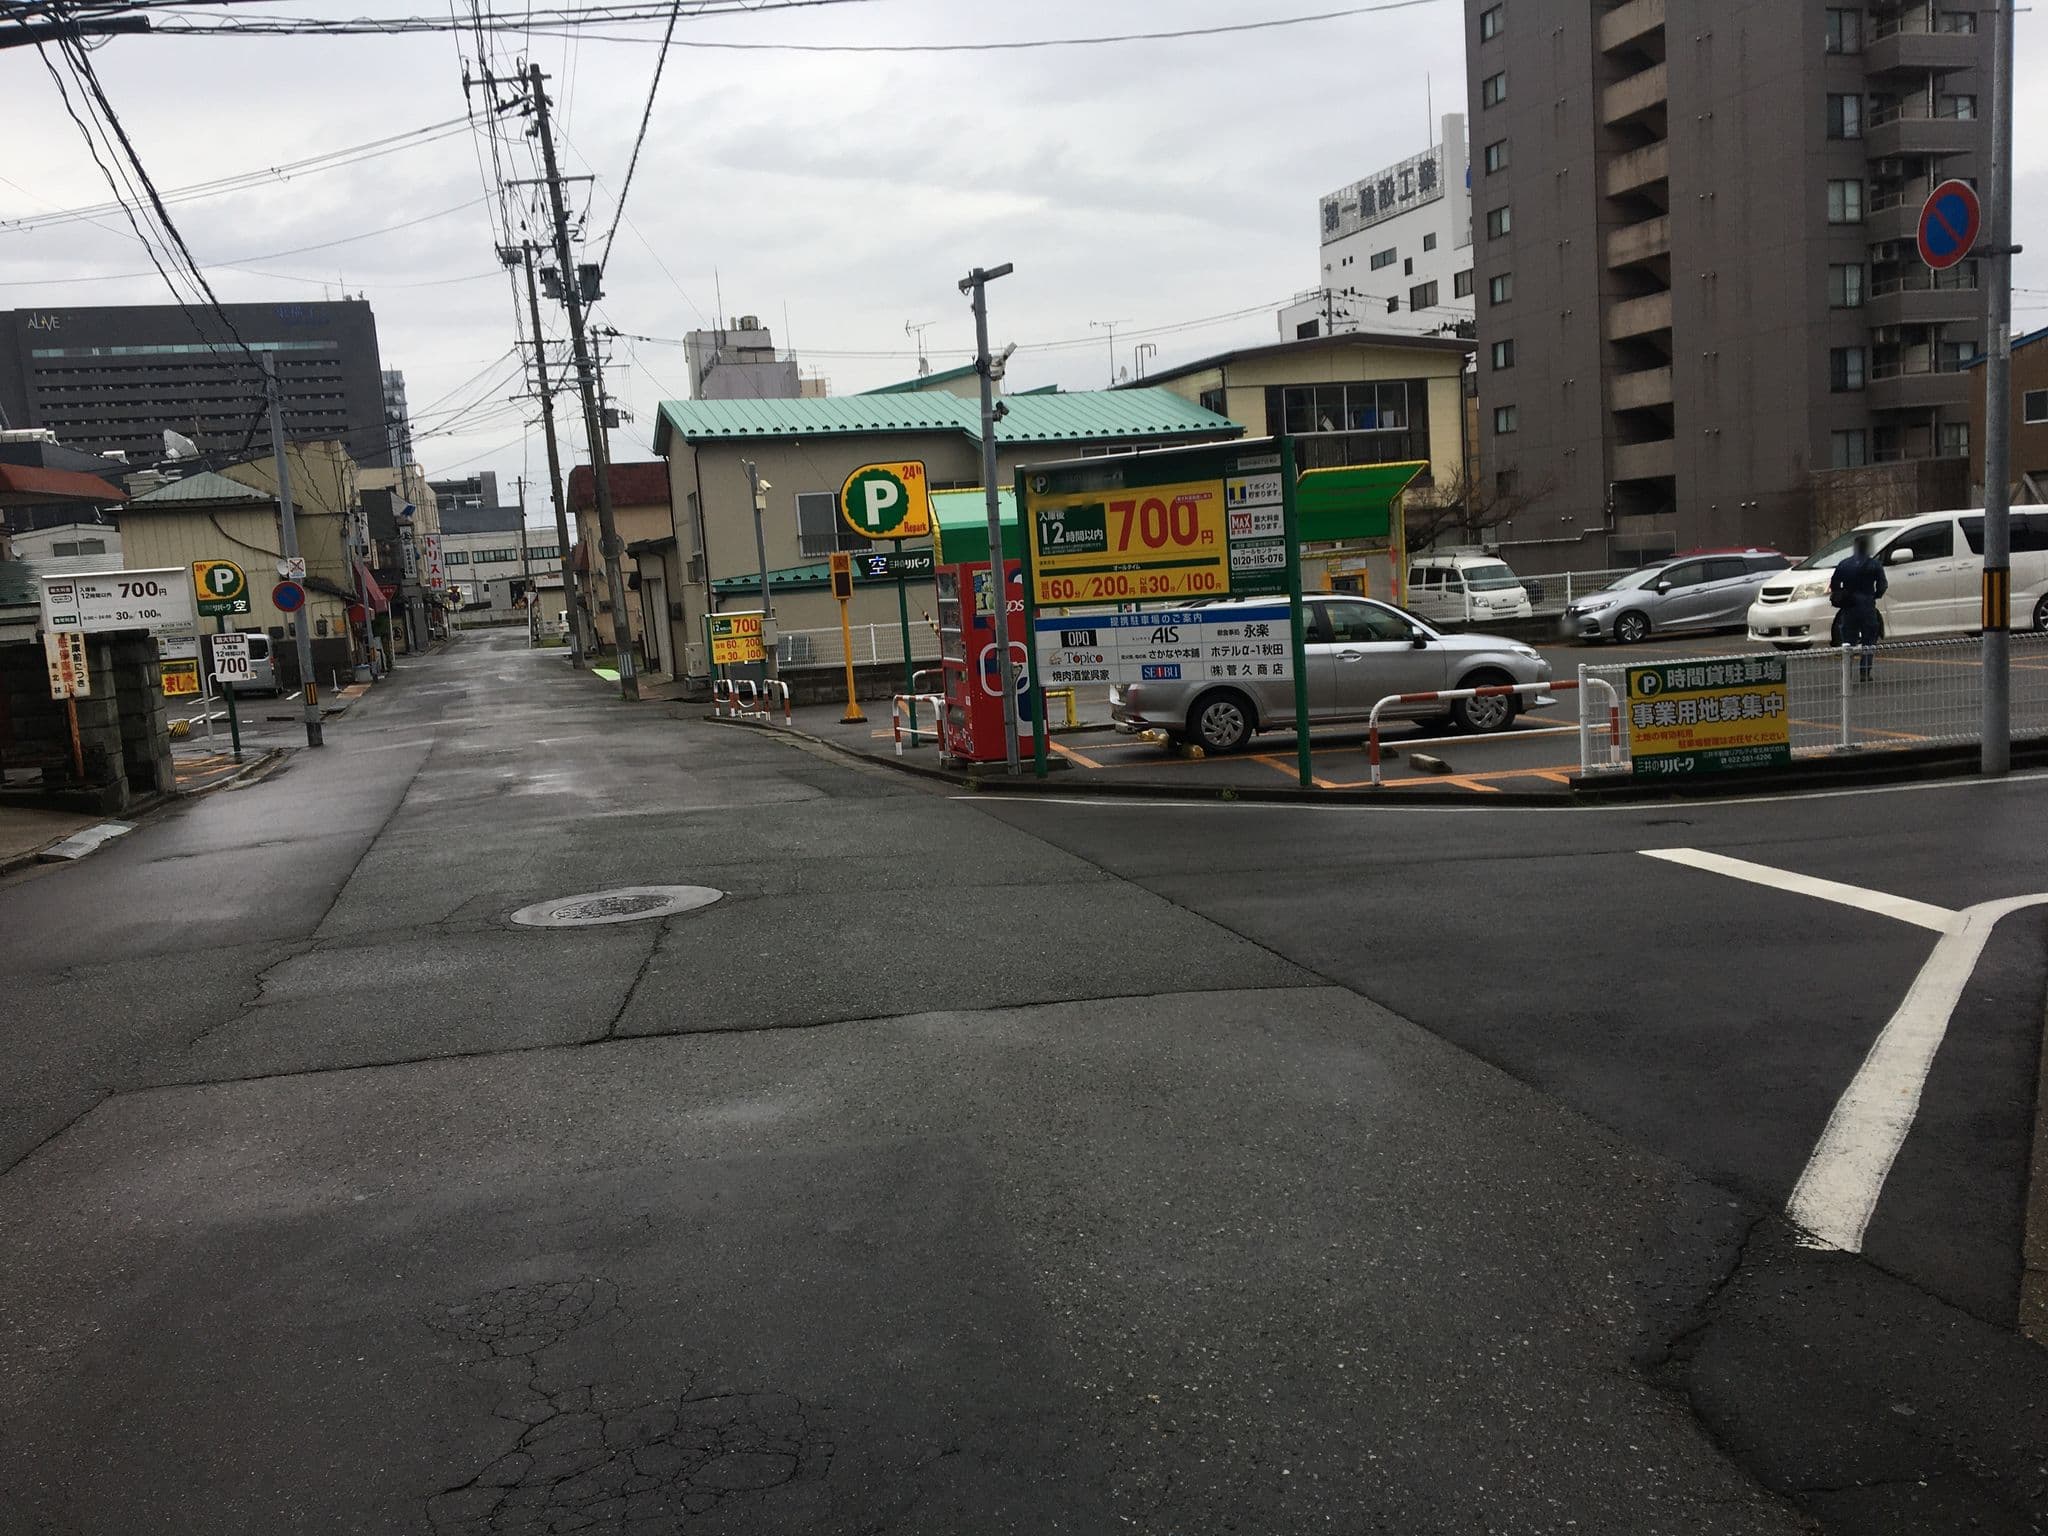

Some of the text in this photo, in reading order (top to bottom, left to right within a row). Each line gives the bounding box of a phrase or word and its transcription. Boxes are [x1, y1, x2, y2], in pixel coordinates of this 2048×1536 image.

[864, 480, 899, 526] P
[903, 522, 926, 534] Repark
[1231, 514, 1252, 529] MAX
[426, 536, 443, 588] トリス軒
[868, 555, 888, 575] 空
[214, 568, 234, 593] P
[233, 599, 248, 612] 空
[1111, 613, 1202, 627] 提携駐車場のご案内
[1244, 624, 1270, 638] 永楽
[217, 658, 248, 674] 700
[1643, 676, 1656, 693] P
[1632, 691, 1785, 729] 事業用地募集中
